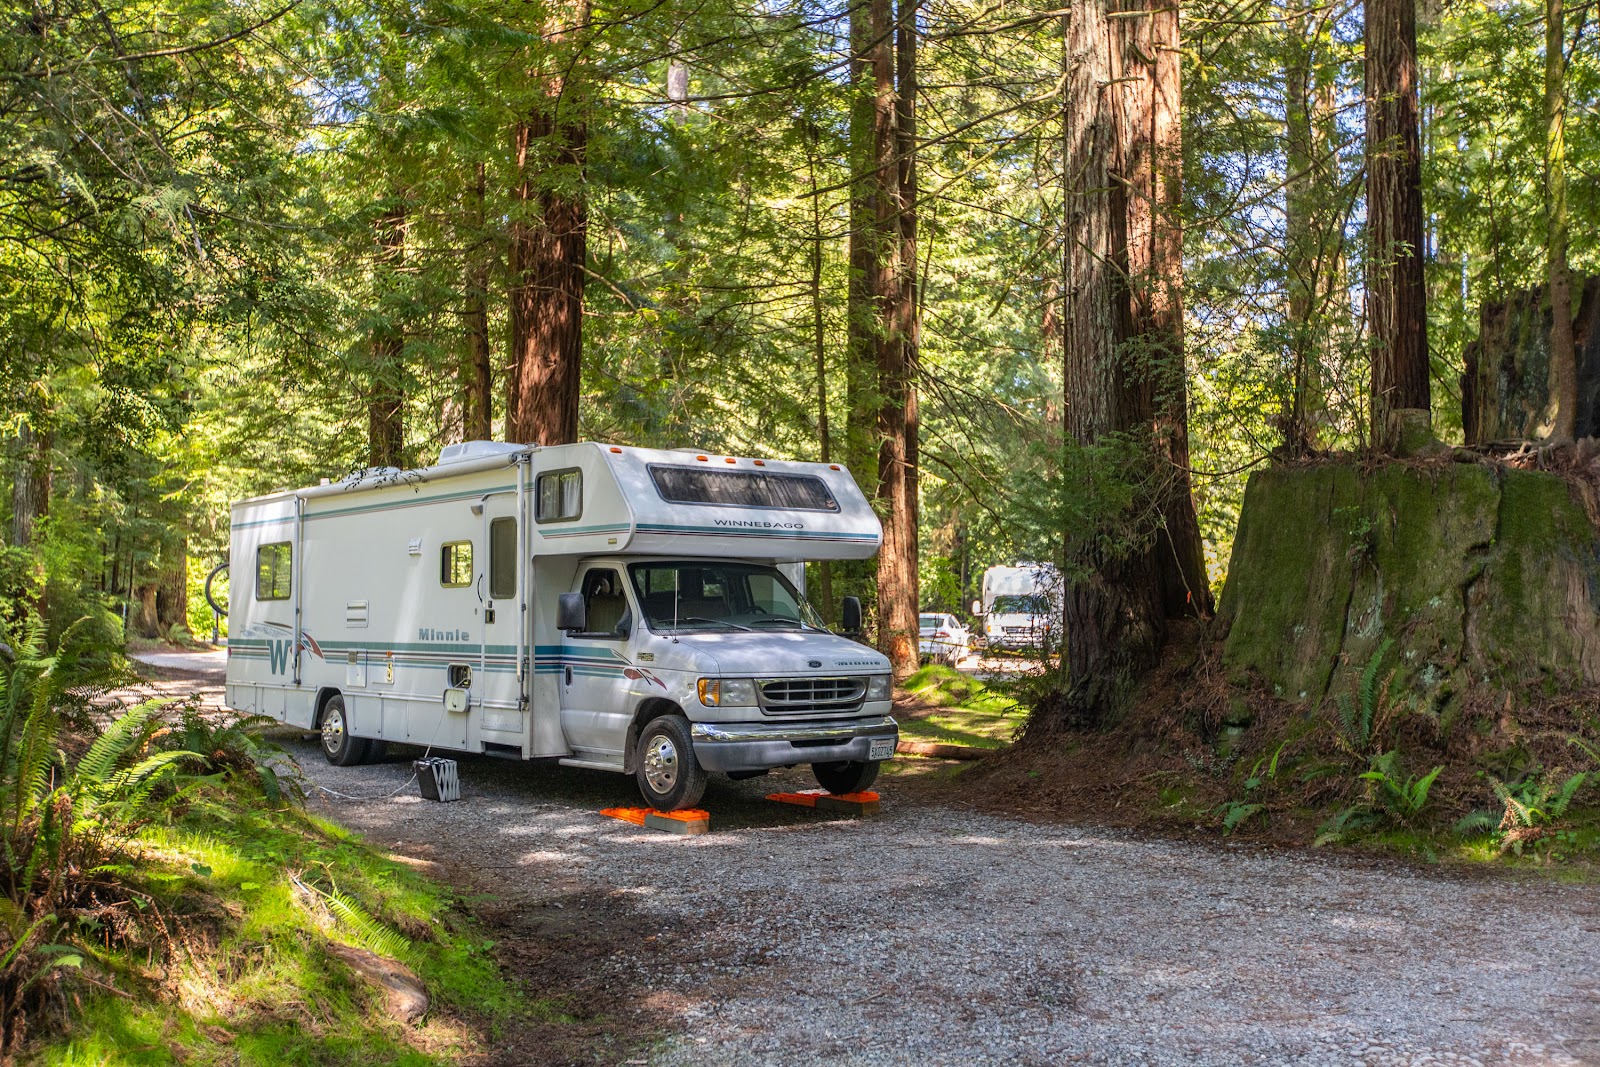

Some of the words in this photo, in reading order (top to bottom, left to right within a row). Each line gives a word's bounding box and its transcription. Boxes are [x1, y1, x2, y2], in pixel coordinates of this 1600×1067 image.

[714, 519, 804, 529] WINNEBAGO
[418, 628, 470, 641] Minnie
[266, 639, 293, 675] W
